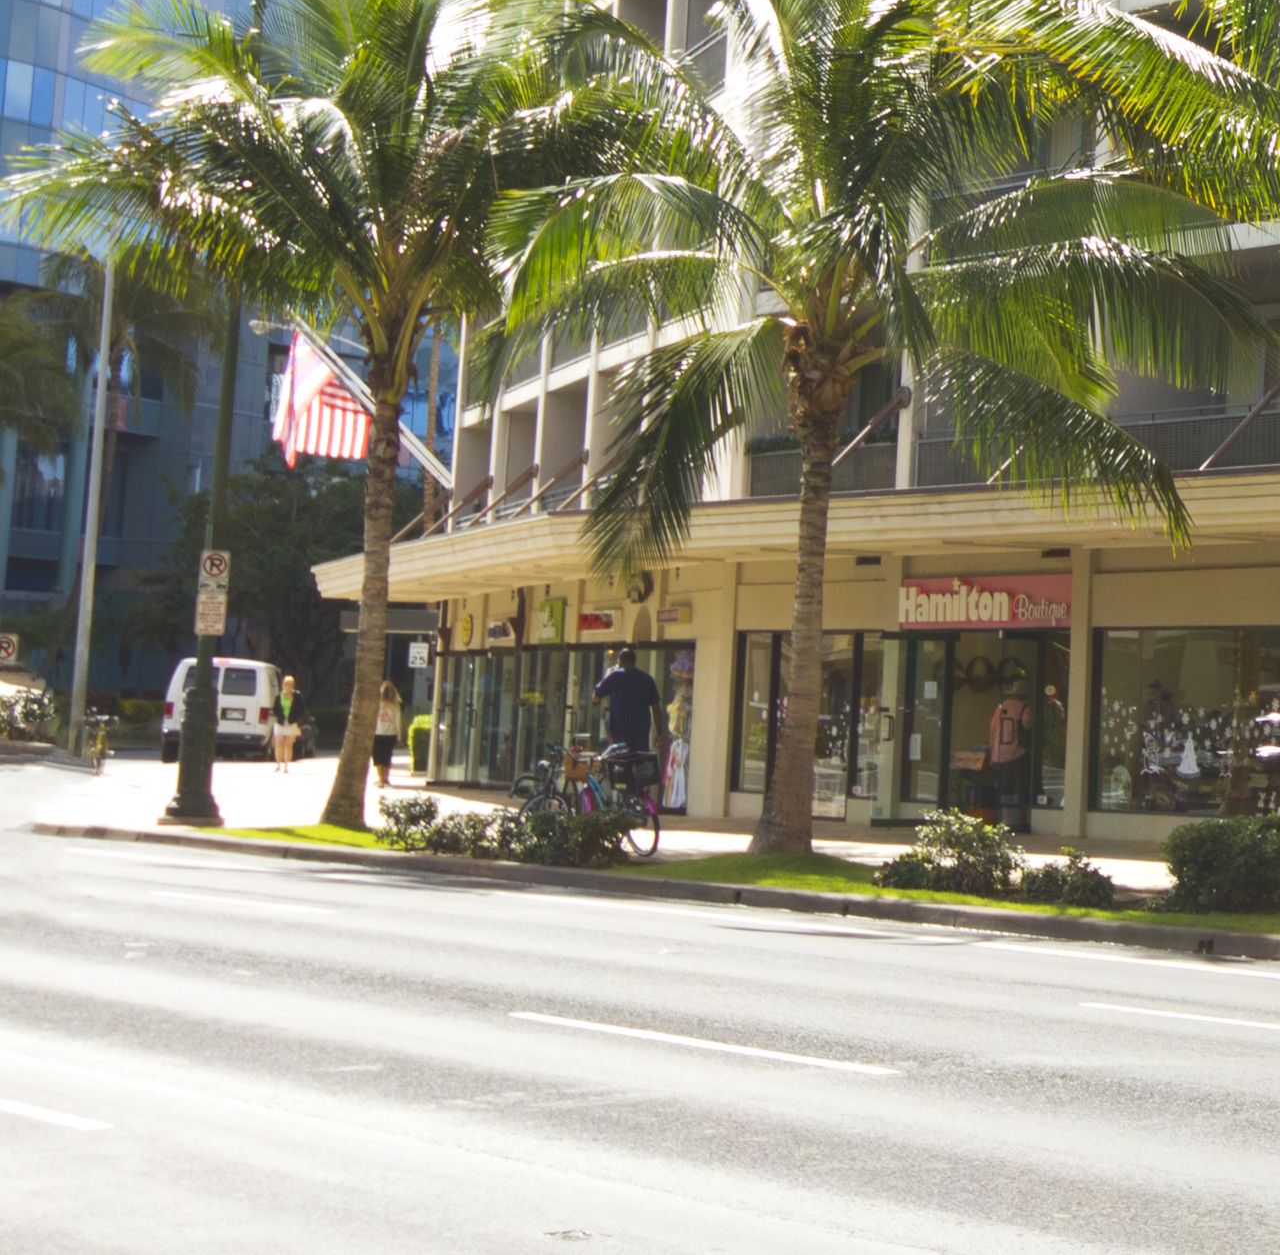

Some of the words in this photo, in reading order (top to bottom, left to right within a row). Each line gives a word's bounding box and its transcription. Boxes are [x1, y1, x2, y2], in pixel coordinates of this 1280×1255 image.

[898, 577, 1010, 623] Hamilton
[1013, 594, 1068, 627] Boutique
[410, 656, 426, 665] 25
